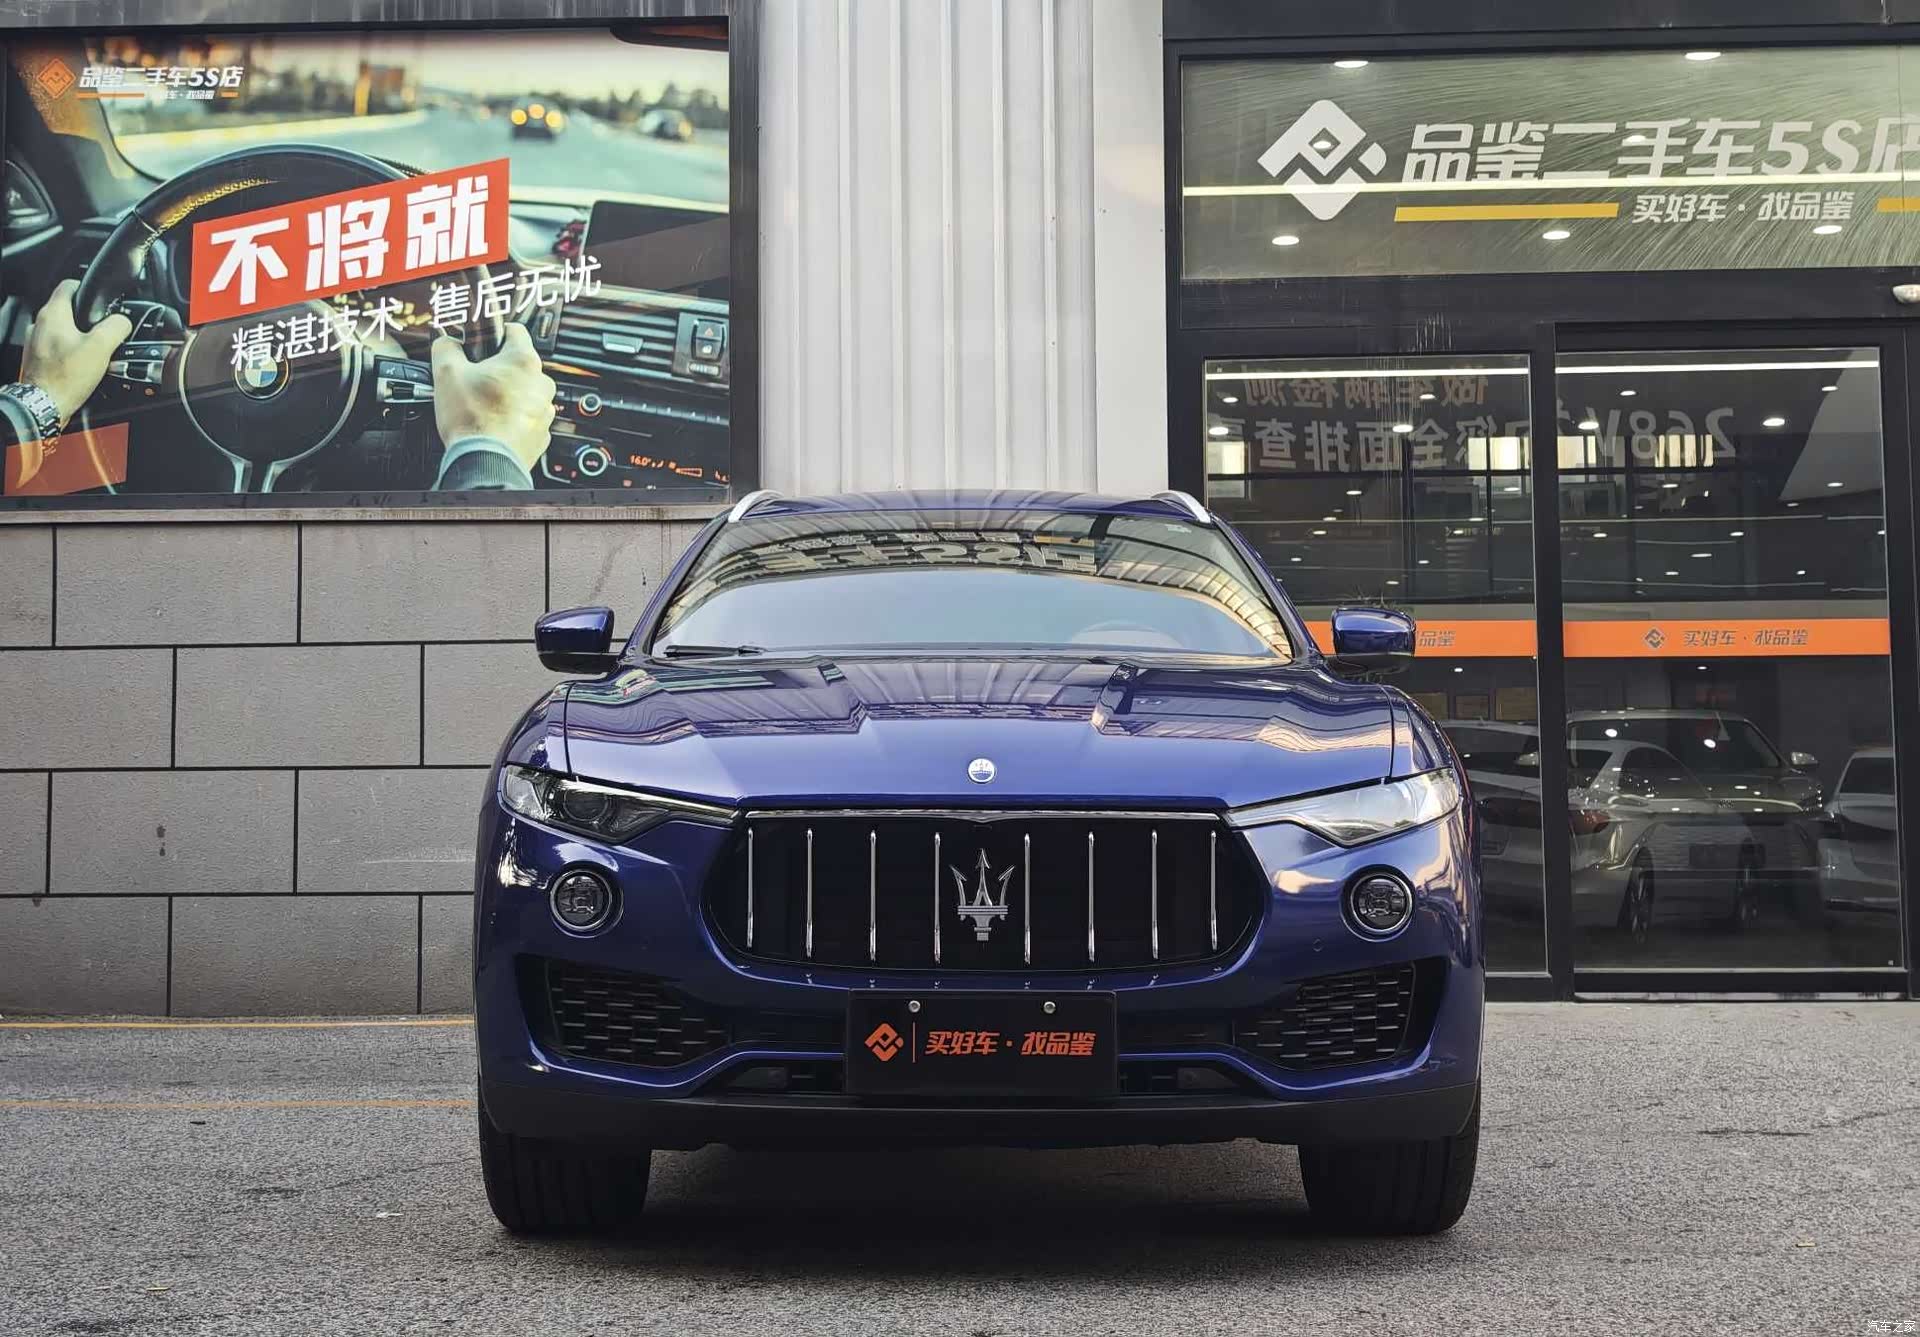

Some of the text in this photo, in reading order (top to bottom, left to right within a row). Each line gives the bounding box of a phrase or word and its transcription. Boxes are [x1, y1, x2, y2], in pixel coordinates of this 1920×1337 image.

[78, 66, 244, 88] 品鉴二手车5S店
[208, 174, 490, 306] 不将就
[229, 254, 603, 371] 精湛技术 售后无忧
[1416, 630, 1456, 647] 品鉴
[925, 1031, 1096, 1056] 买好车·找品鉴
